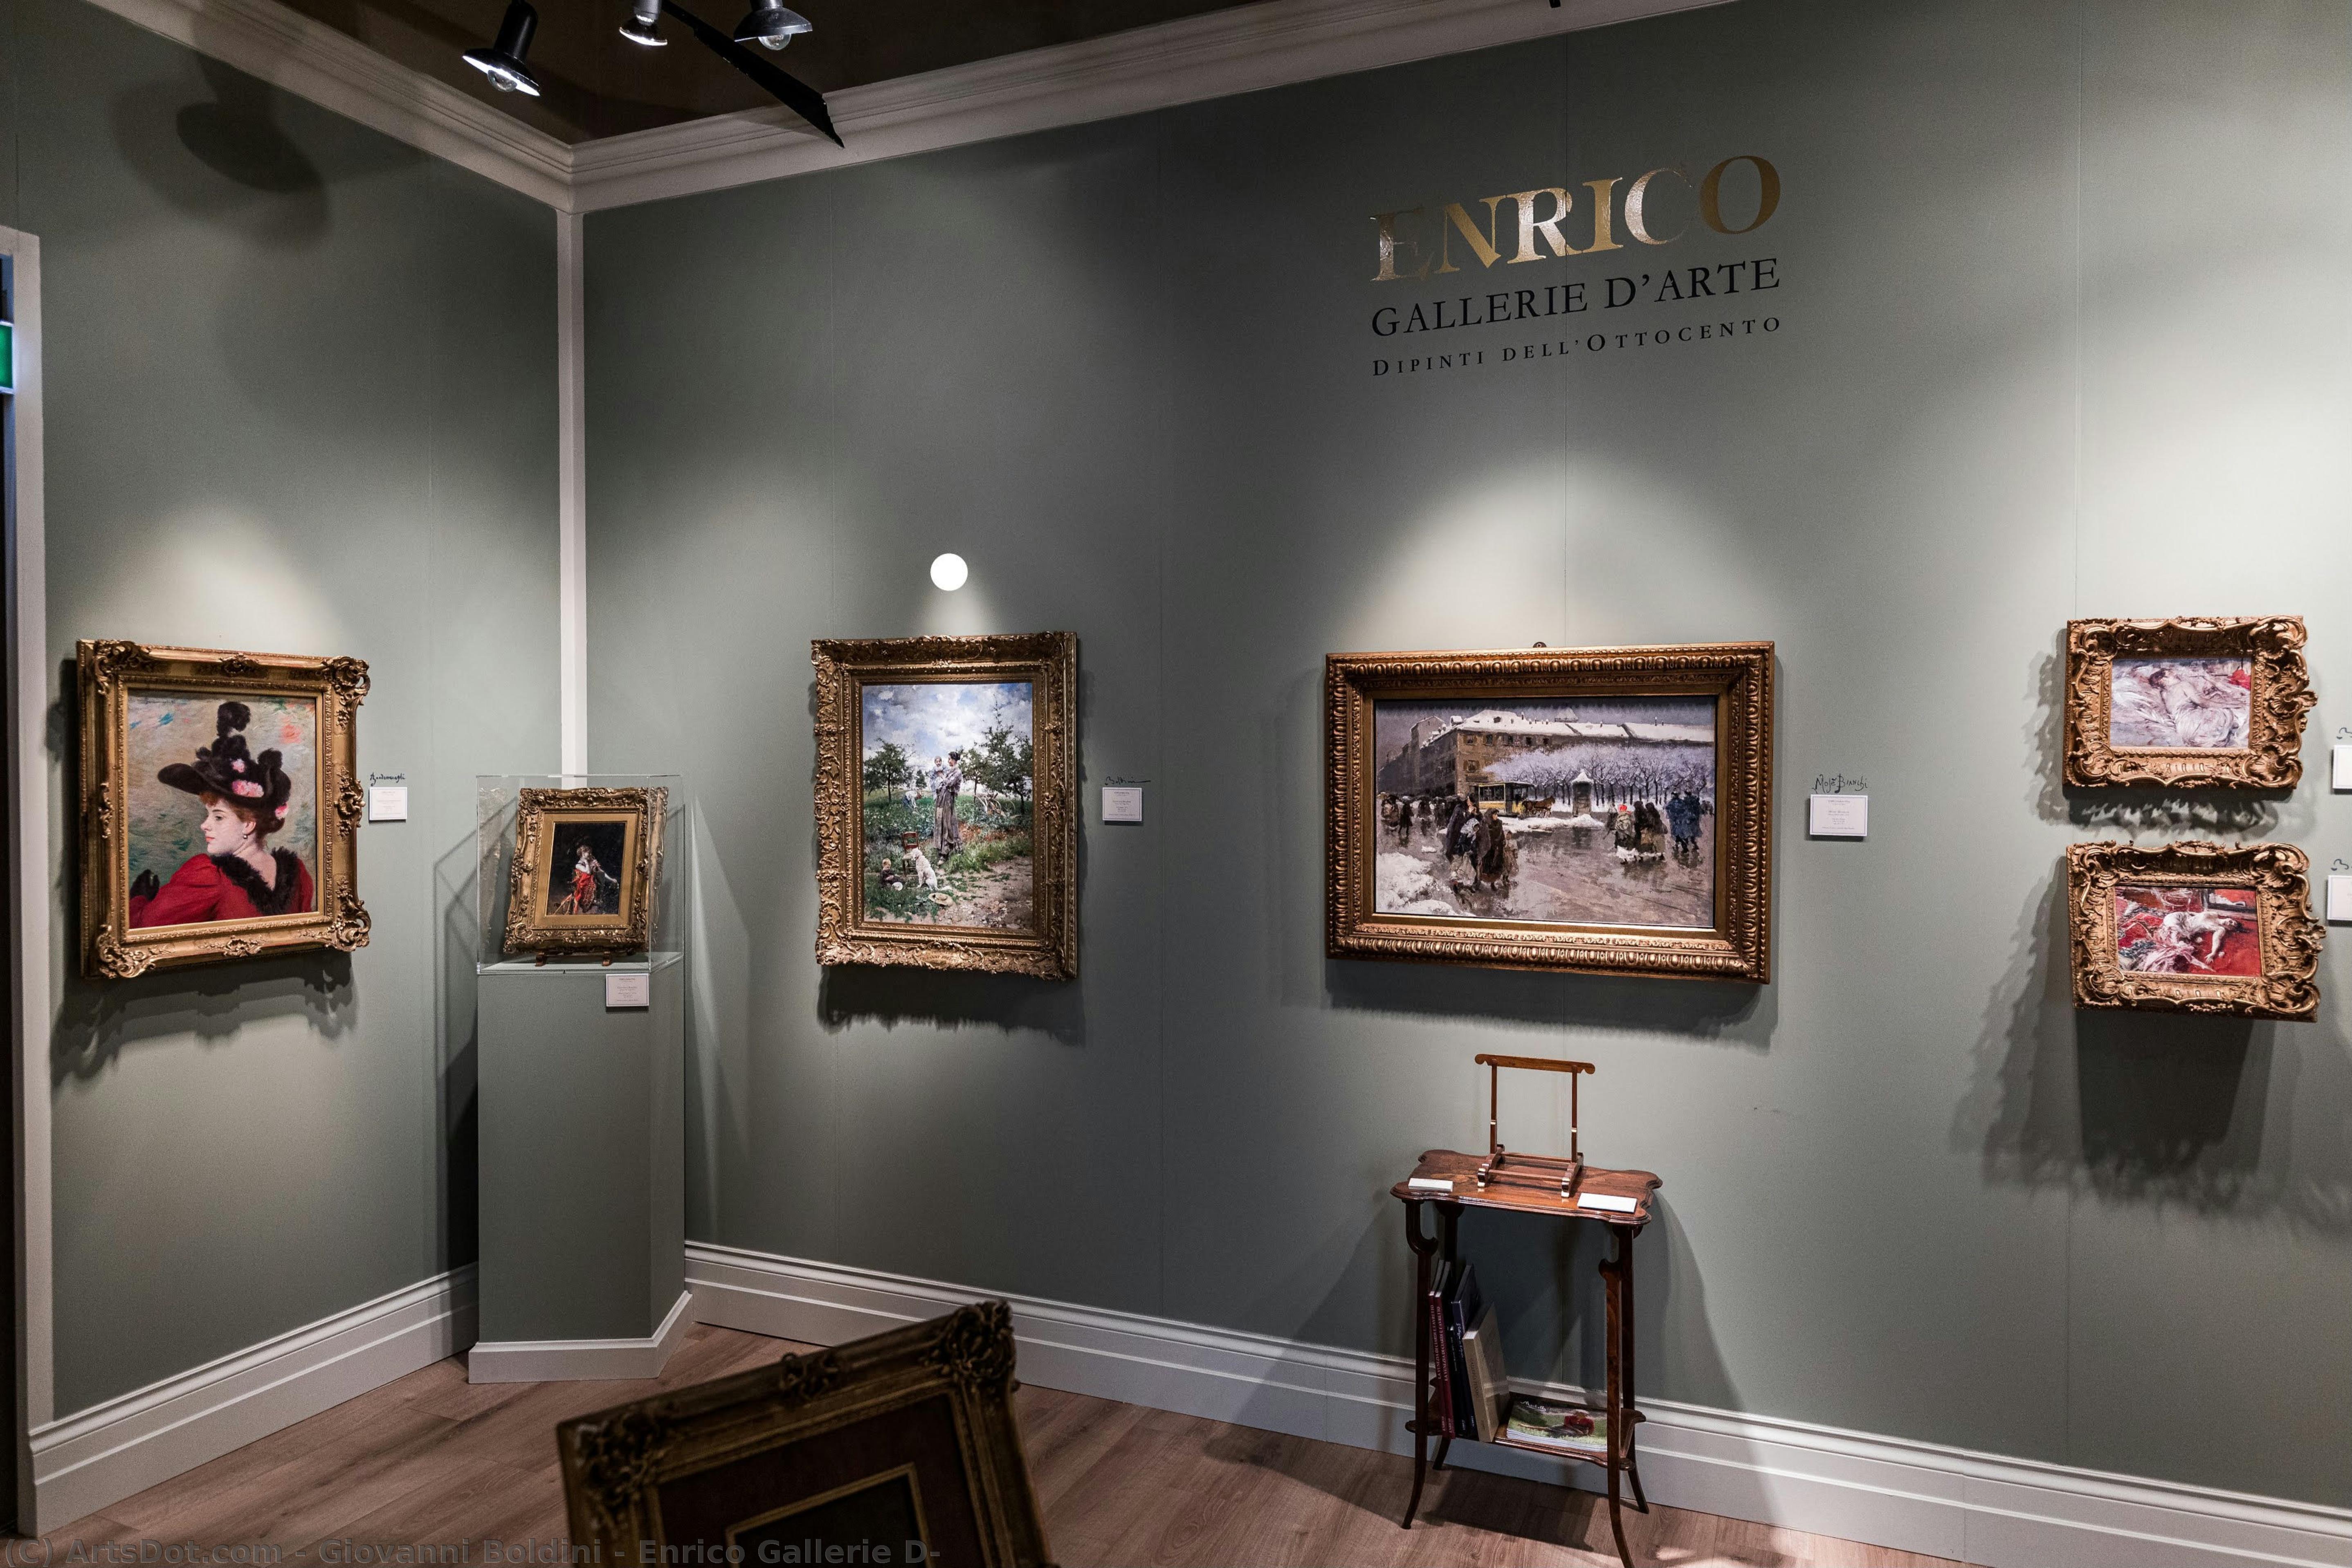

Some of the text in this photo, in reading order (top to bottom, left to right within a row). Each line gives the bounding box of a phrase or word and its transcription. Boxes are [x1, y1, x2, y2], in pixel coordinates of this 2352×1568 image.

[1370, 155, 1781, 281] ENRICO
[1371, 258, 1780, 337] GALLERIE D'ARTE
[1373, 350, 1484, 376] DIPINTI
